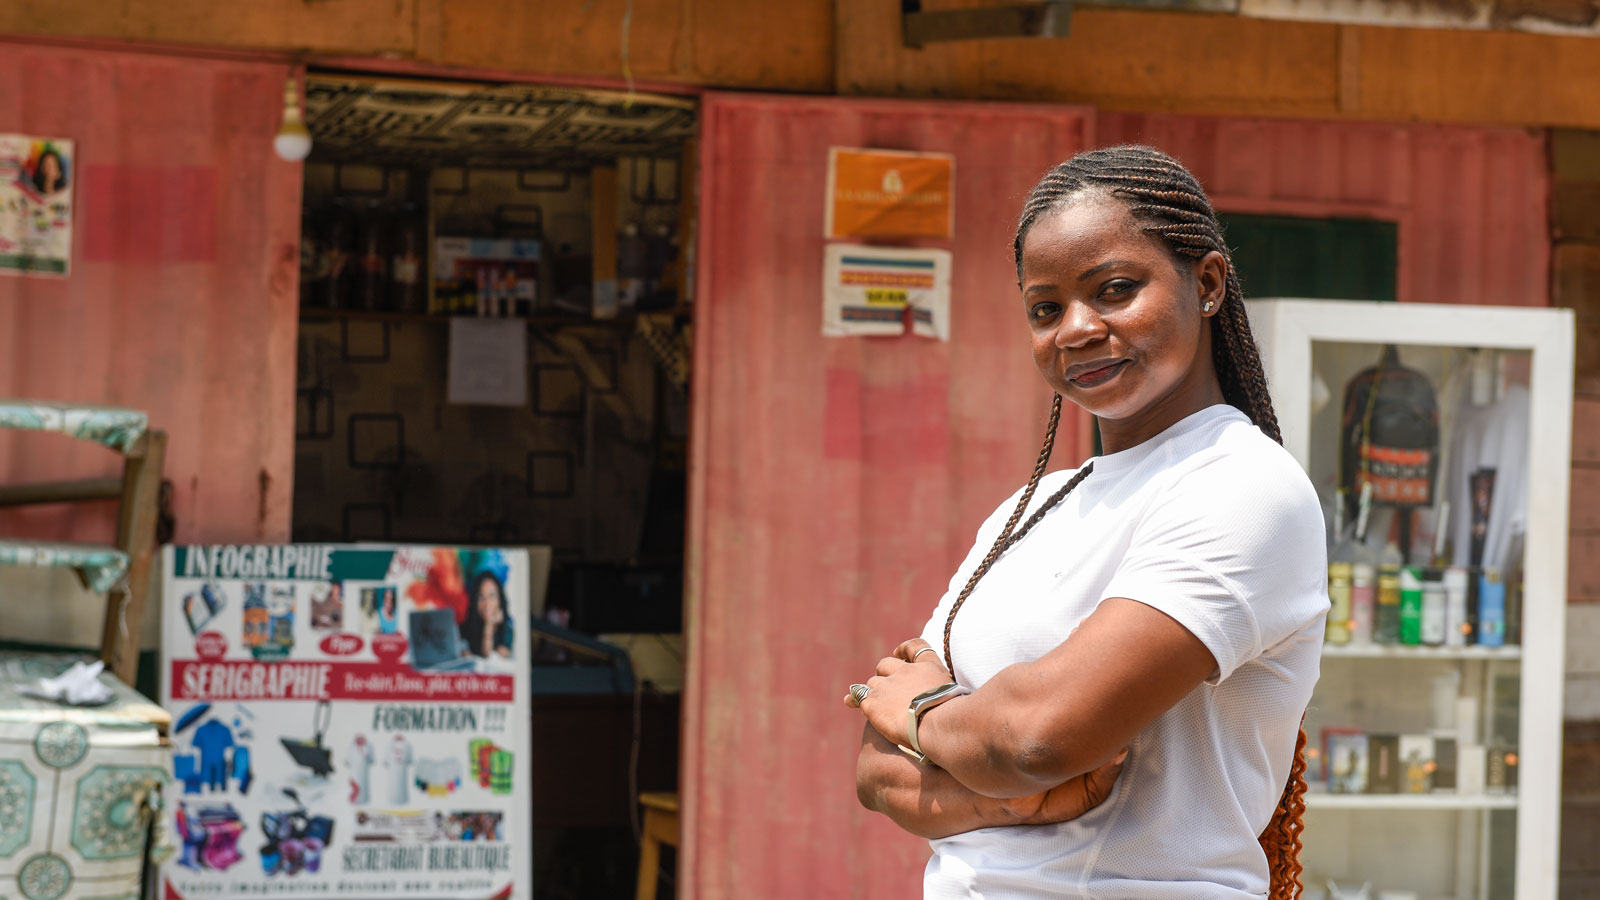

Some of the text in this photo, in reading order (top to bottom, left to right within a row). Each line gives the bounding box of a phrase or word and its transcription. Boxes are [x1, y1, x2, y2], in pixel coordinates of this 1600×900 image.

[184, 544, 334, 578] INFOGRAPHIE
[182, 664, 332, 698] SERIGRAPHIE
[372, 705, 477, 733] FORMATION
